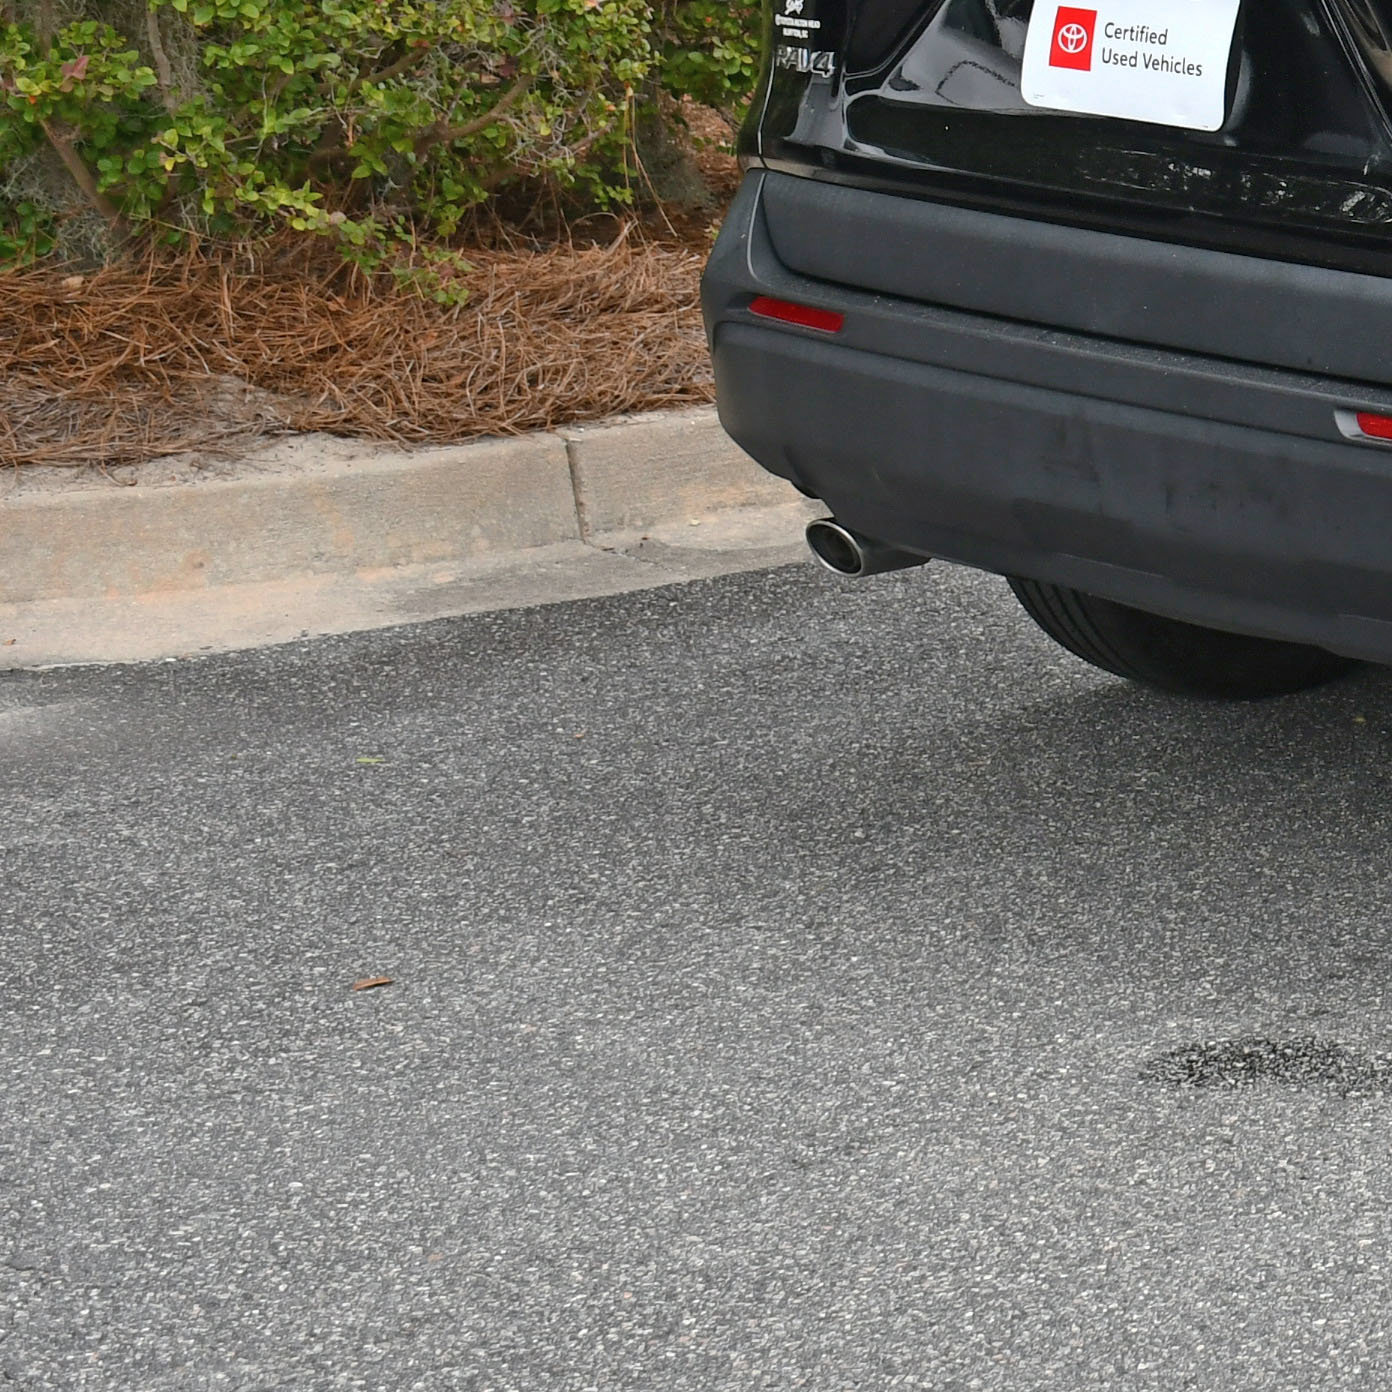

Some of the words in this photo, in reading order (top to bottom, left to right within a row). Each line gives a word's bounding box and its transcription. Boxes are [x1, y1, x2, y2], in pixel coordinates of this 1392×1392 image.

[1104, 21, 1168, 45] Certified
[1102, 48, 1138, 68] Used
[1143, 53, 1203, 77] Vehicles
